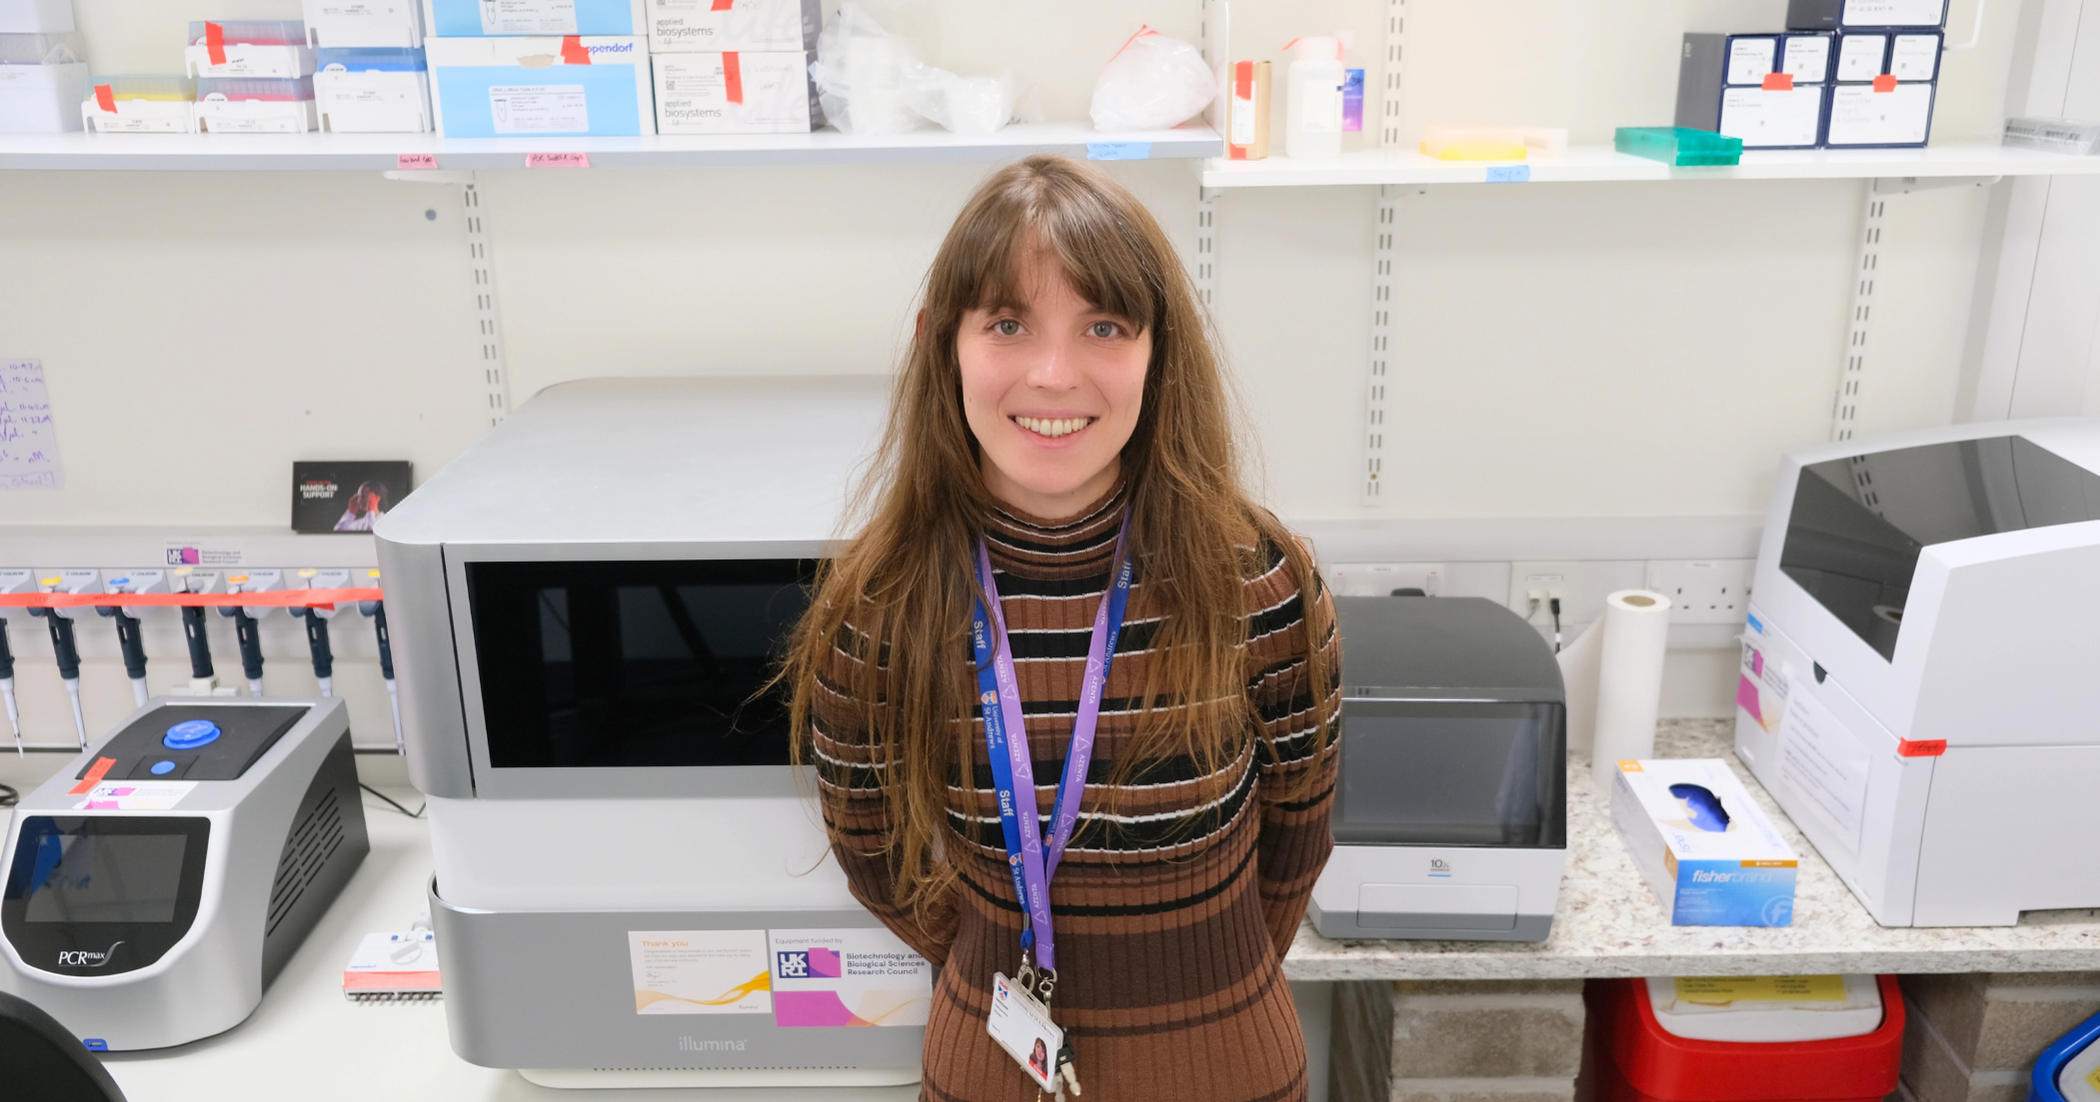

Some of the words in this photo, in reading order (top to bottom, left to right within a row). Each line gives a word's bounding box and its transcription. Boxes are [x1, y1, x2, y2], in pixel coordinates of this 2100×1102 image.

[656, 18, 684, 26] applied
[656, 27, 714, 38] biosystems
[664, 100, 692, 108] applied
[664, 108, 722, 120] biosystems
[300, 484, 338, 492] HANDS-ON
[303, 491, 335, 499] SUPPORT
[1118, 561, 1131, 590] Staff
[974, 621, 986, 649] Staff
[1088, 674, 1098, 705] AZENTA
[1011, 733, 1021, 763] AZENTA
[1075, 753, 1086, 783] AZENTA
[999, 789, 1014, 817] Staff
[1022, 811, 1031, 839] AZENTA
[1692, 869, 1773, 883] fisherbrand
[846, 952, 906, 961] Biotechnology
[847, 960, 886, 968] Biological
